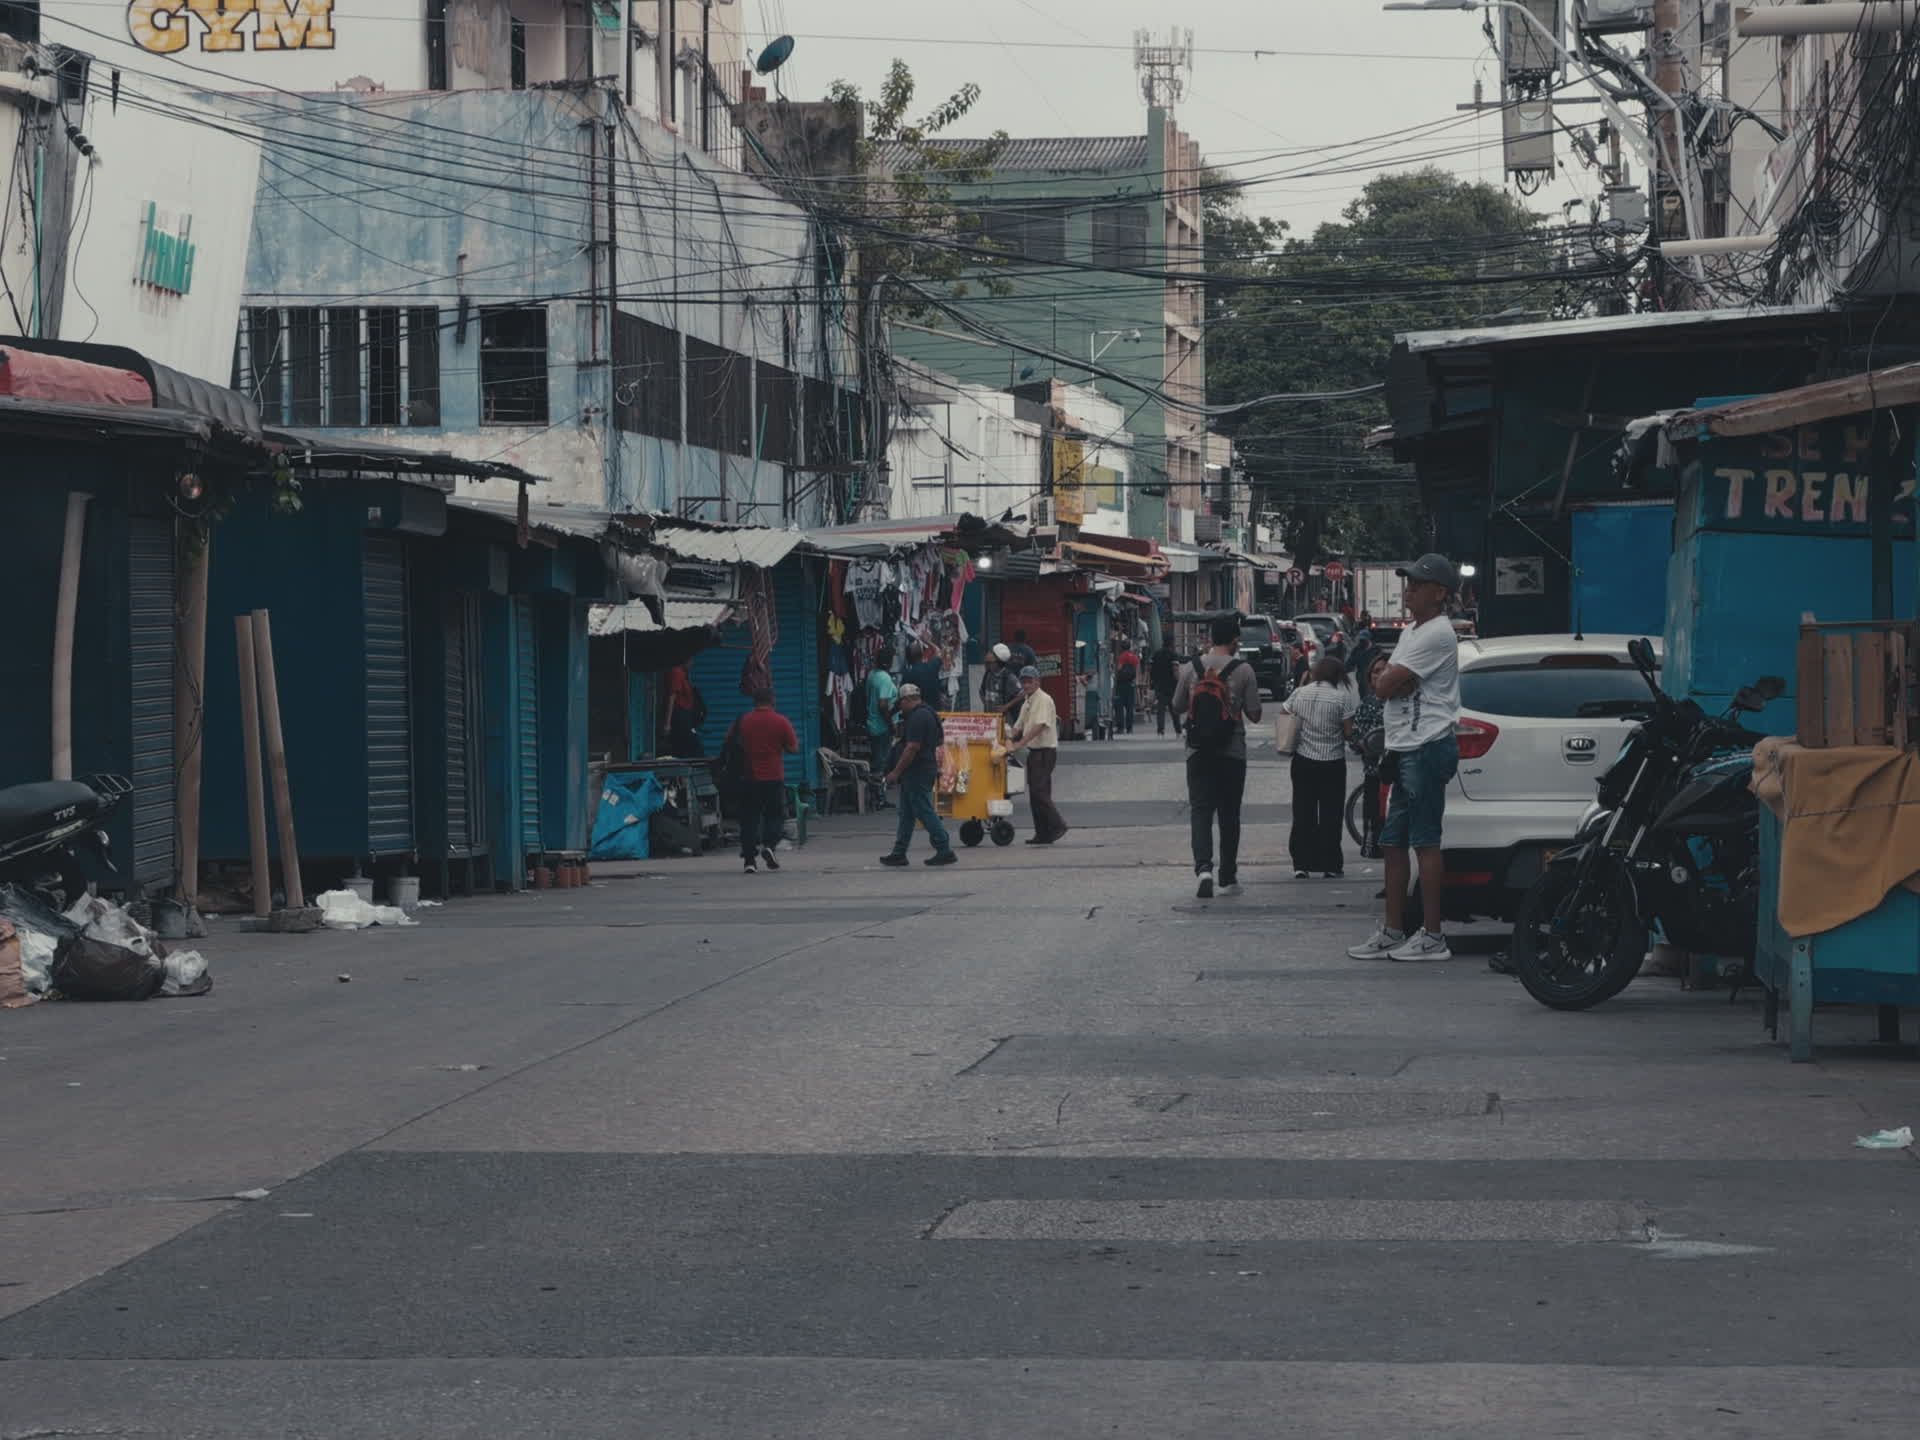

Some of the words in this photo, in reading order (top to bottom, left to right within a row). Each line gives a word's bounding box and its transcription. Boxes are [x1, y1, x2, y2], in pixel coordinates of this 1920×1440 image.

[126, 0, 336, 54] GYM
[1570, 738, 1592, 749] KIA
[54, 806, 76, 821] TVS
